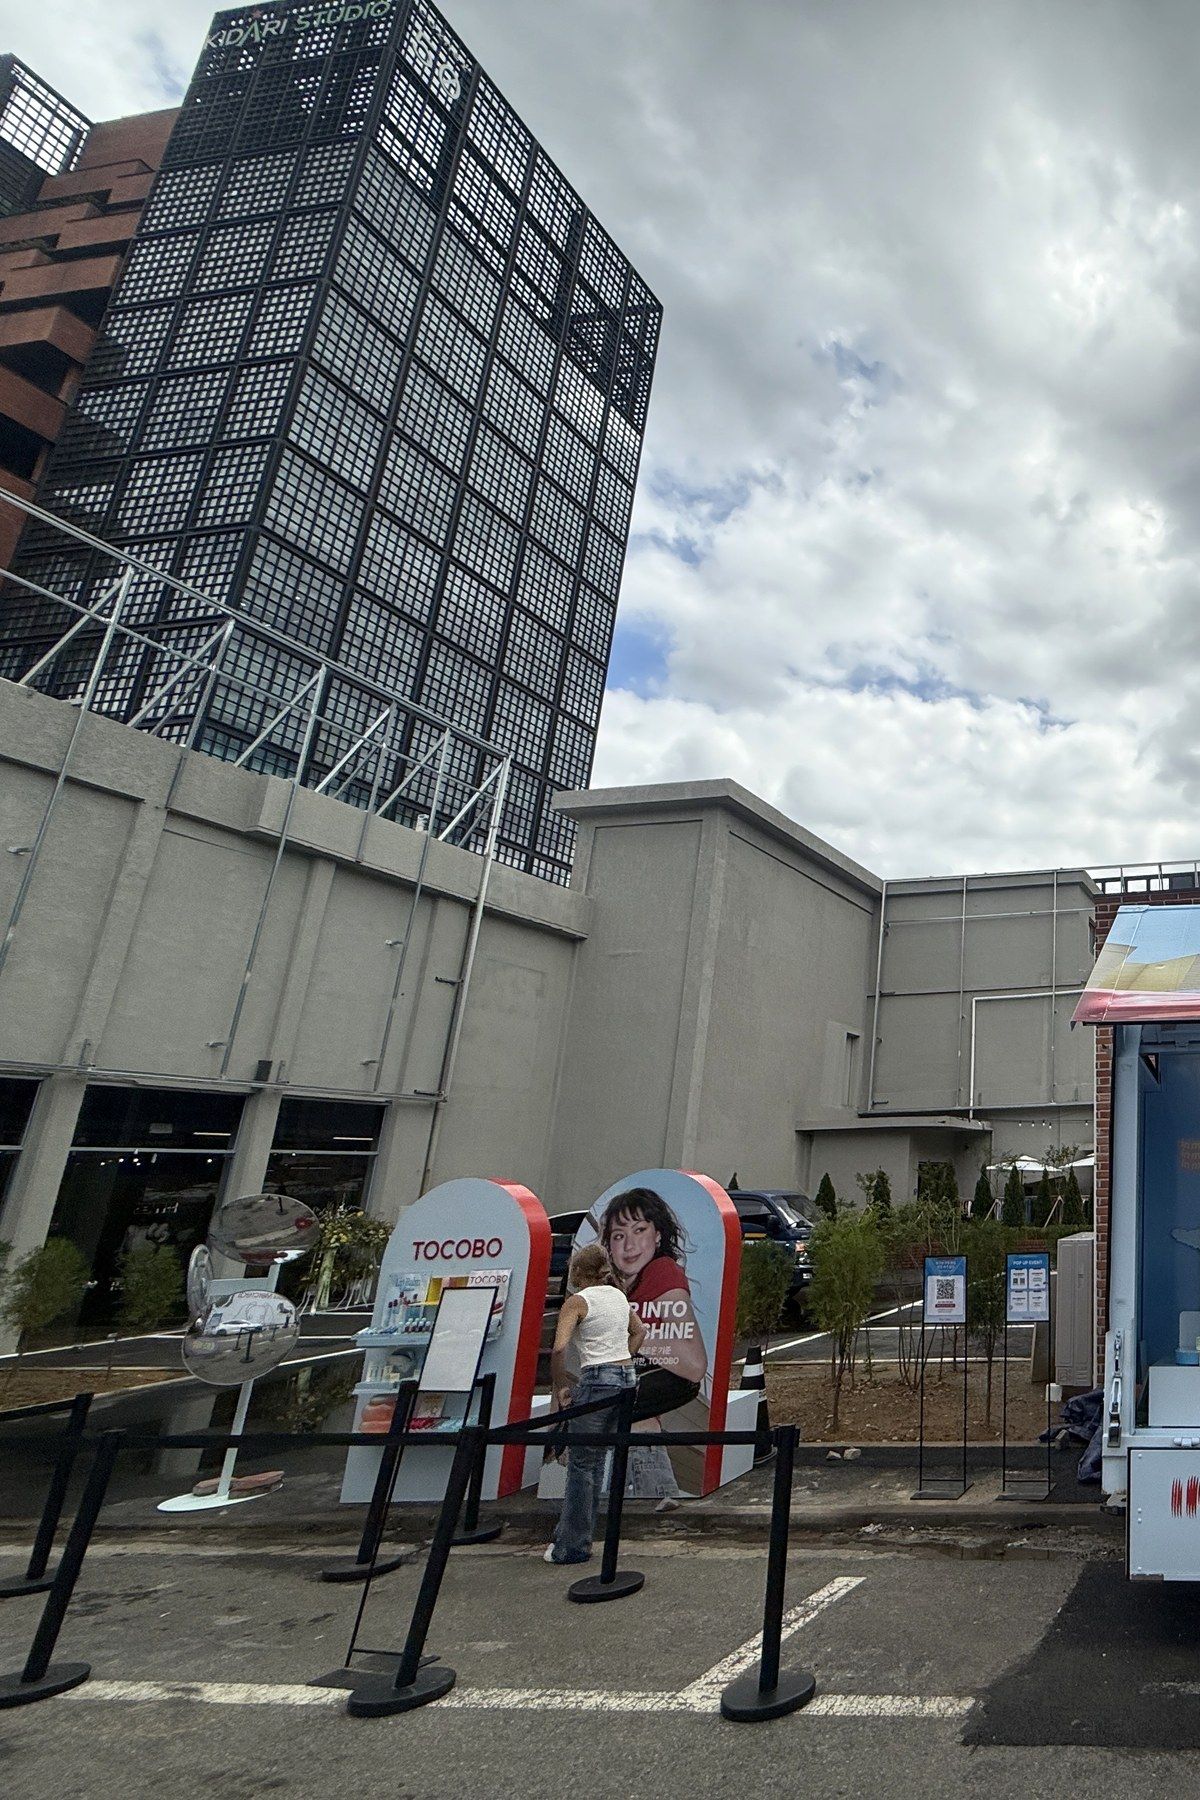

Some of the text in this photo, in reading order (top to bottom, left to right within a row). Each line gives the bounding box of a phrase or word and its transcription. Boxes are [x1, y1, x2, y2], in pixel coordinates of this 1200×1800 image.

[205, 0, 391, 48] KIDARI STUDIO
[412, 1237, 503, 1261] TOCOBO
[469, 1274, 508, 1285] TOCOBO
[642, 1300, 687, 1318] INTO
[643, 1322, 695, 1339] SHINE
[648, 1357, 680, 1365] TOCOBO
